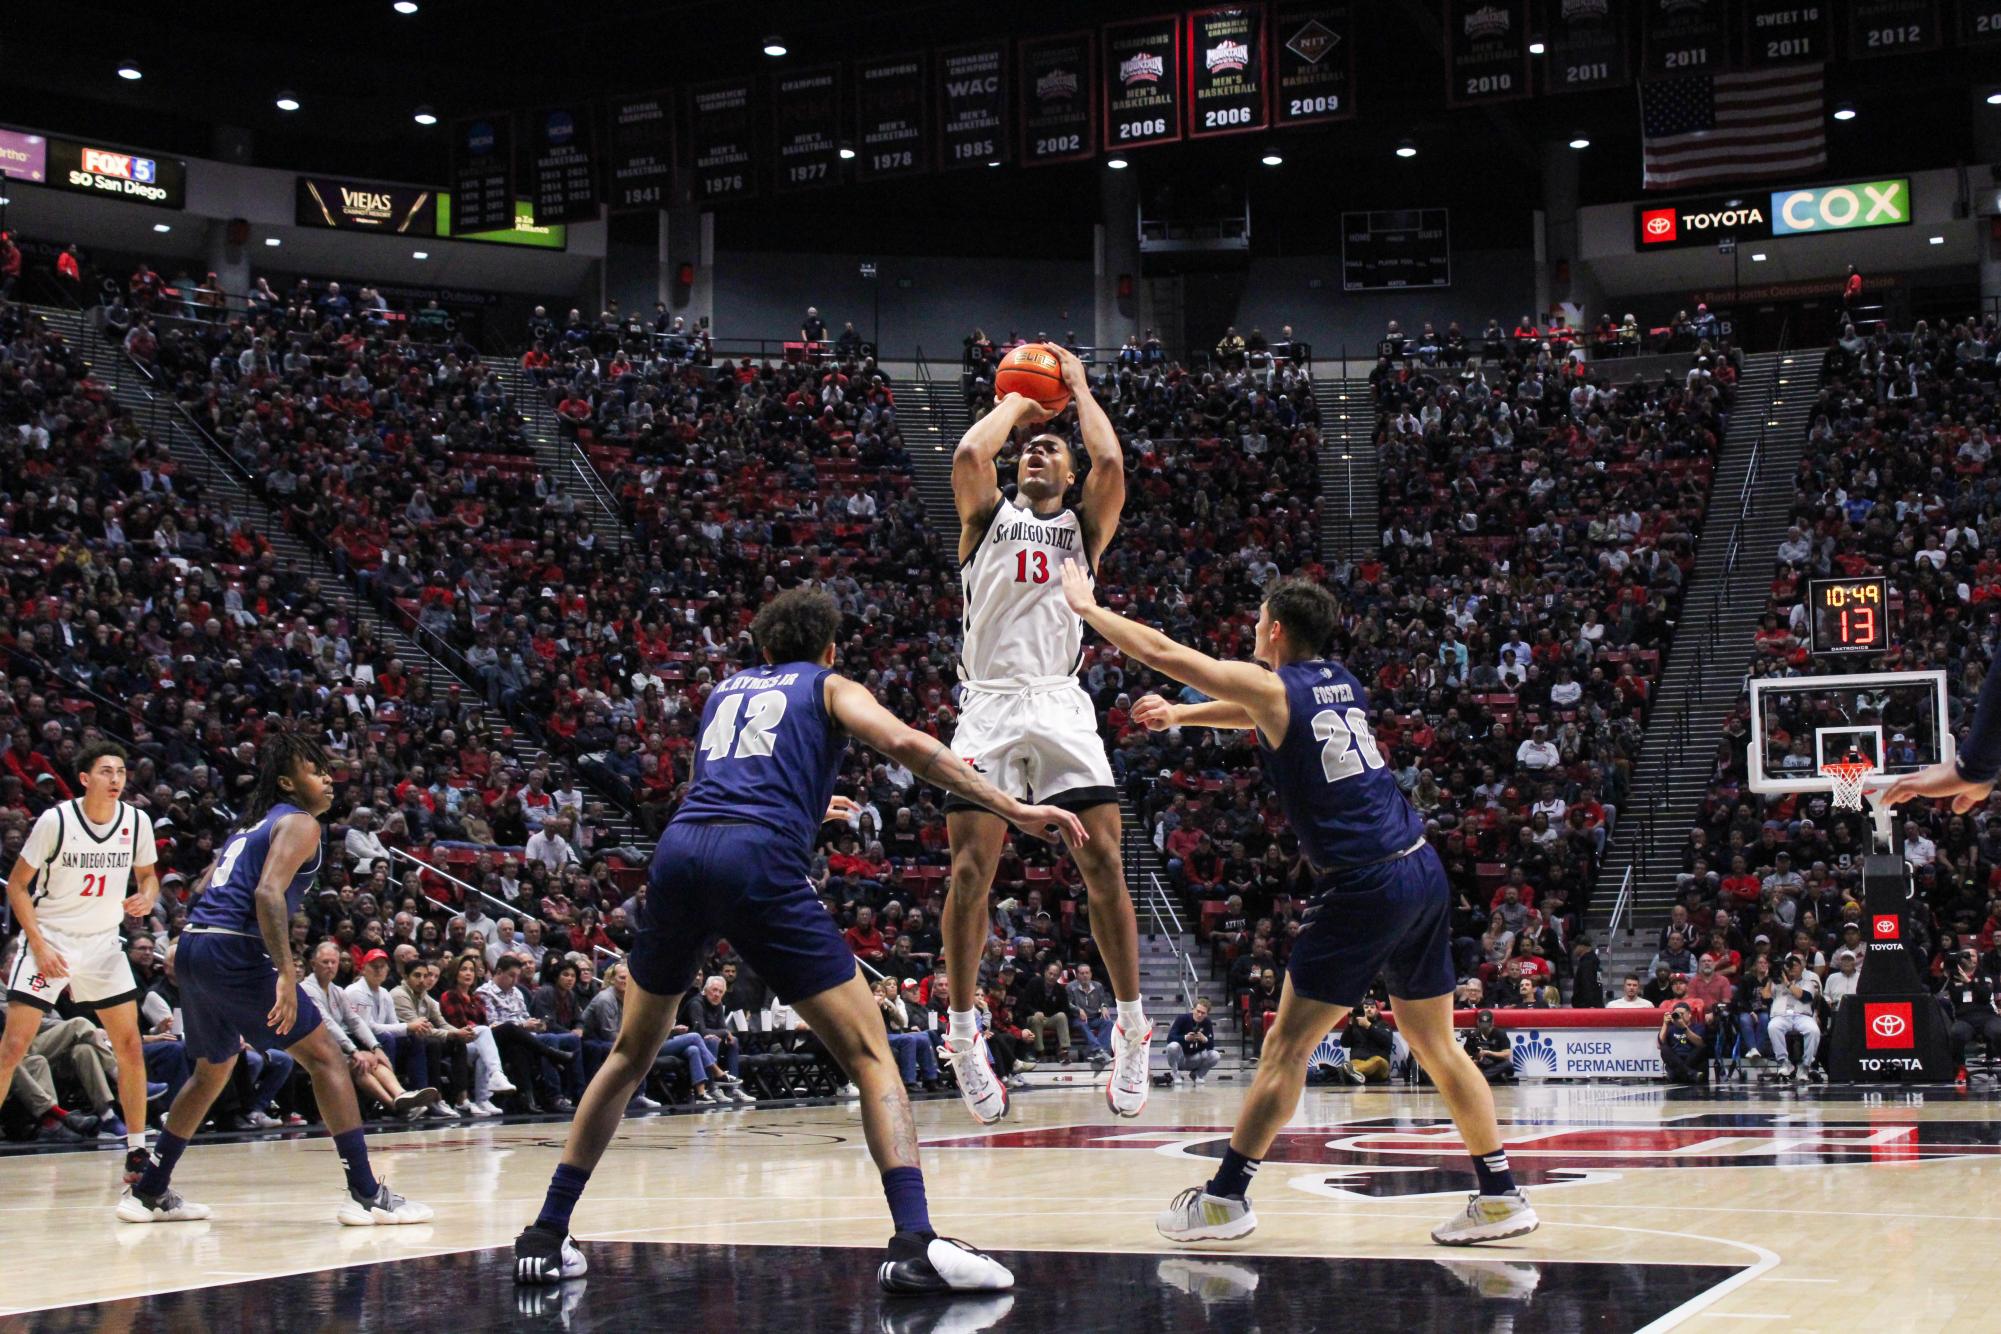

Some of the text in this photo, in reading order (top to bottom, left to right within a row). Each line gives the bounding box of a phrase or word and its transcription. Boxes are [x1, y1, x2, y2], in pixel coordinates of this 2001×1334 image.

[1205, 19, 1248, 31] TOURNAMENT
[1755, 7, 1819, 28] SWEET 16
[1208, 26, 1248, 37] CHAMPIONS
[1300, 36, 1327, 48] NIT
[1867, 25, 1920, 48] 2012
[1112, 34, 1169, 51] CHAMPIONS
[1767, 37, 1810, 58] 2011
[1665, 48, 1706, 69] 2011
[1212, 74, 1242, 87] MEN'S
[1567, 63, 1608, 83] 2011
[946, 77, 999, 98] WAC
[1126, 86, 1157, 99] MEN'S
[1198, 83, 1257, 99] BASKETBALL
[1467, 74, 1511, 95] 2010
[1112, 94, 1172, 111] BASKETBALL
[1290, 95, 1339, 117] 2009
[1205, 107, 1251, 128] 2006
[1119, 118, 1166, 140] 2006
[954, 140, 994, 160] 1985
[1036, 134, 1081, 155] 2002
[85, 151, 150, 180] FOX 5
[872, 151, 912, 171] 1978
[789, 163, 828, 183] 1977
[69, 171, 167, 201] SO San Diego
[705, 174, 743, 195] 1976
[340, 186, 392, 212] VIEJAS
[624, 187, 660, 205] 1941
[1782, 183, 1902, 231] COX
[1682, 208, 1764, 231] TOYOTA
[1721, 322, 1733, 335] B
[860, 344, 871, 356] C
[1383, 343, 1393, 355] B
[1010, 521, 1043, 544] DIEGO
[1045, 526, 1076, 551] STATE
[1015, 549, 1050, 584] 13
[1826, 585, 1878, 607] 10:49
[1841, 607, 1874, 643] 13
[1312, 683, 1354, 705] FOSTER
[700, 690, 787, 761] 42
[1311, 708, 1385, 783] 20
[62, 851, 131, 868] SAN DIEGO STATE
[211, 837, 247, 888] 3
[1839, 853, 1852, 869] 9
[80, 874, 107, 897] 21
[1870, 943, 1904, 951] TOYOTA
[1567, 1042, 1612, 1055] KAISER
[1567, 1059, 1661, 1072] PERMANENTE
